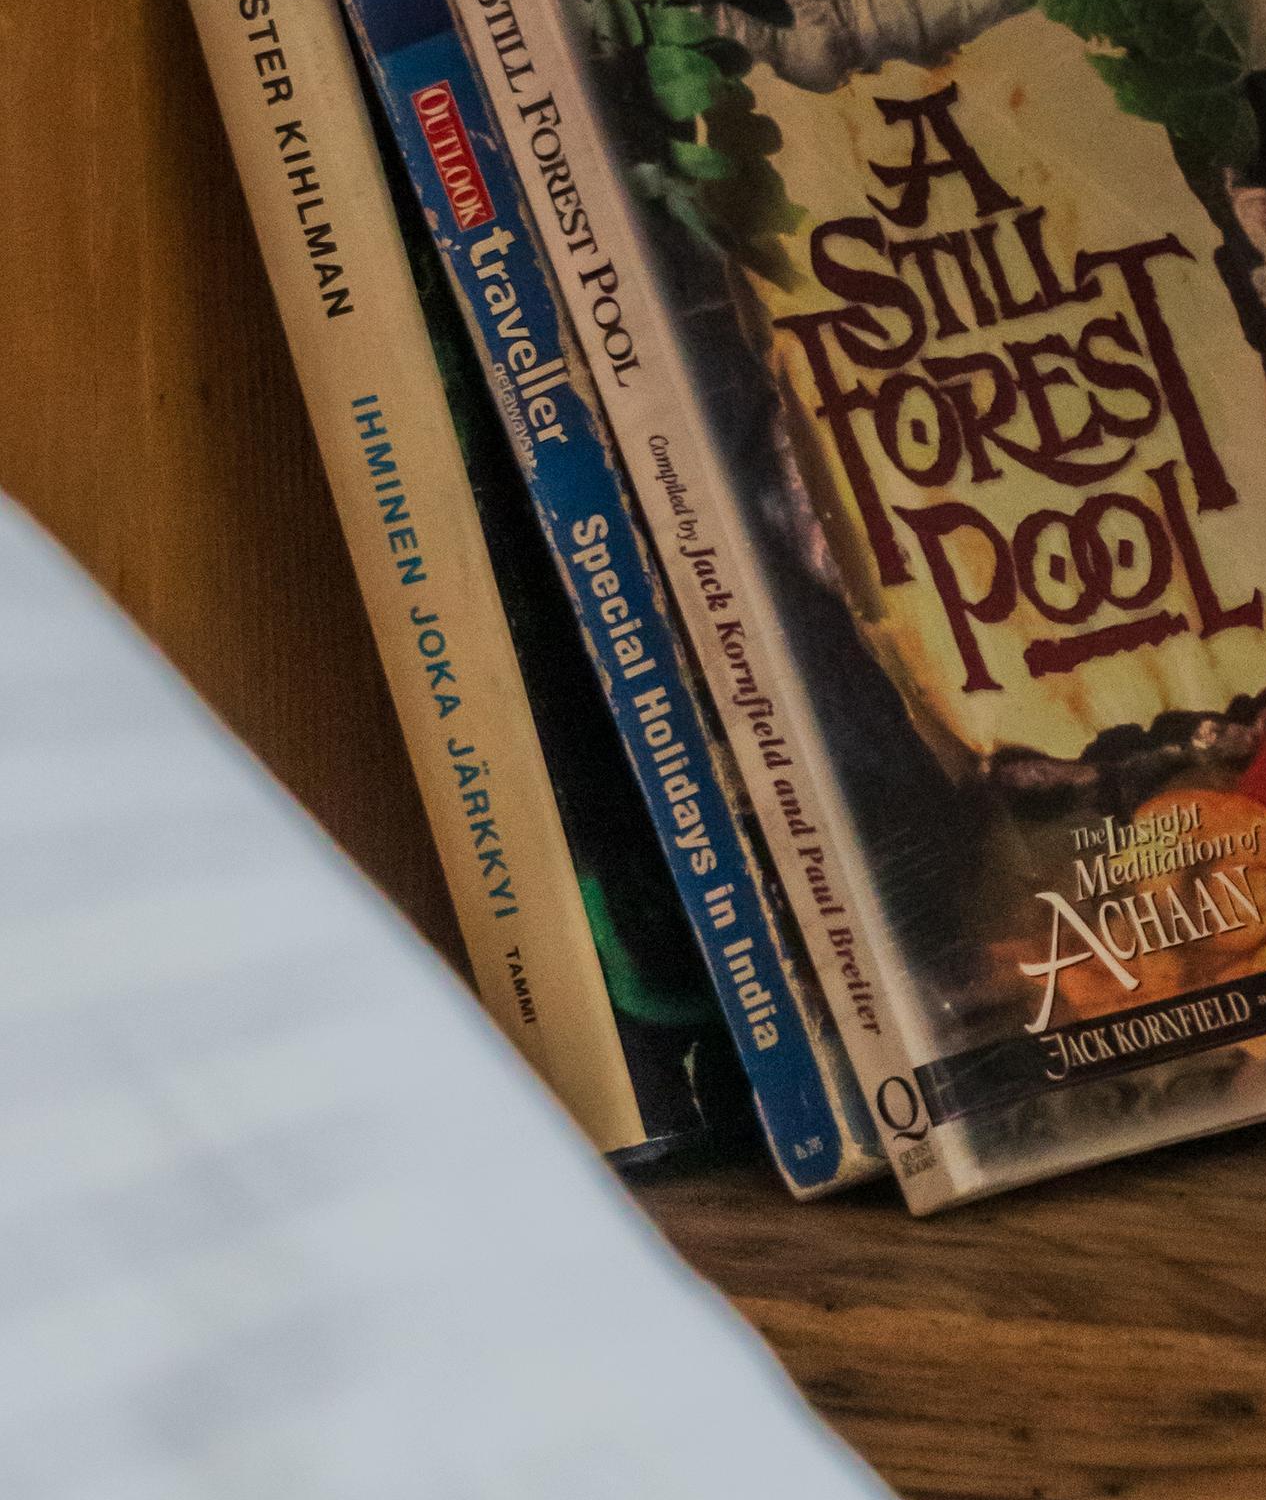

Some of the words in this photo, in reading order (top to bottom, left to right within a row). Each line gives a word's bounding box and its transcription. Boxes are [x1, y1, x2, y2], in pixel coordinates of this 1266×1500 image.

[275, 119, 354, 319] KIHLMAN
[866, 80, 1022, 228] A
[417, 86, 485, 228] OUTLOOK
[469, 226, 570, 445] traveller
[517, 91, 599, 257] FOREST
[579, 257, 642, 388] POOL
[810, 206, 1102, 370] STILL
[648, 434, 695, 516] Compiled
[773, 233, 1238, 587] FOREST
[676, 518, 698, 547] by
[680, 546, 733, 612] Jack
[891, 460, 1265, 692] POOL
[351, 394, 427, 586] IHMINEN
[410, 605, 462, 720] JOKA
[447, 737, 520, 920] JÄRKKYI
[715, 620, 793, 771] Kornfield
[571, 512, 657, 681] Special
[632, 685, 718, 876] Holidays
[703, 883, 737, 930] in
[722, 936, 780, 1053] India
[773, 778, 816, 839] and
[1070, 825, 1108, 852] The
[1103, 802, 1203, 859] Insight
[796, 846, 845, 916] Paul
[1073, 832, 1236, 902] Meditation
[1240, 822, 1262, 856] of
[505, 945, 538, 1025] TAMMI
[828, 927, 882, 1035] Breiter
[1019, 864, 1266, 1035] ACHAAN
[1039, 1025, 1115, 1082] JACK
[1114, 988, 1252, 1055] KORNFIELD
